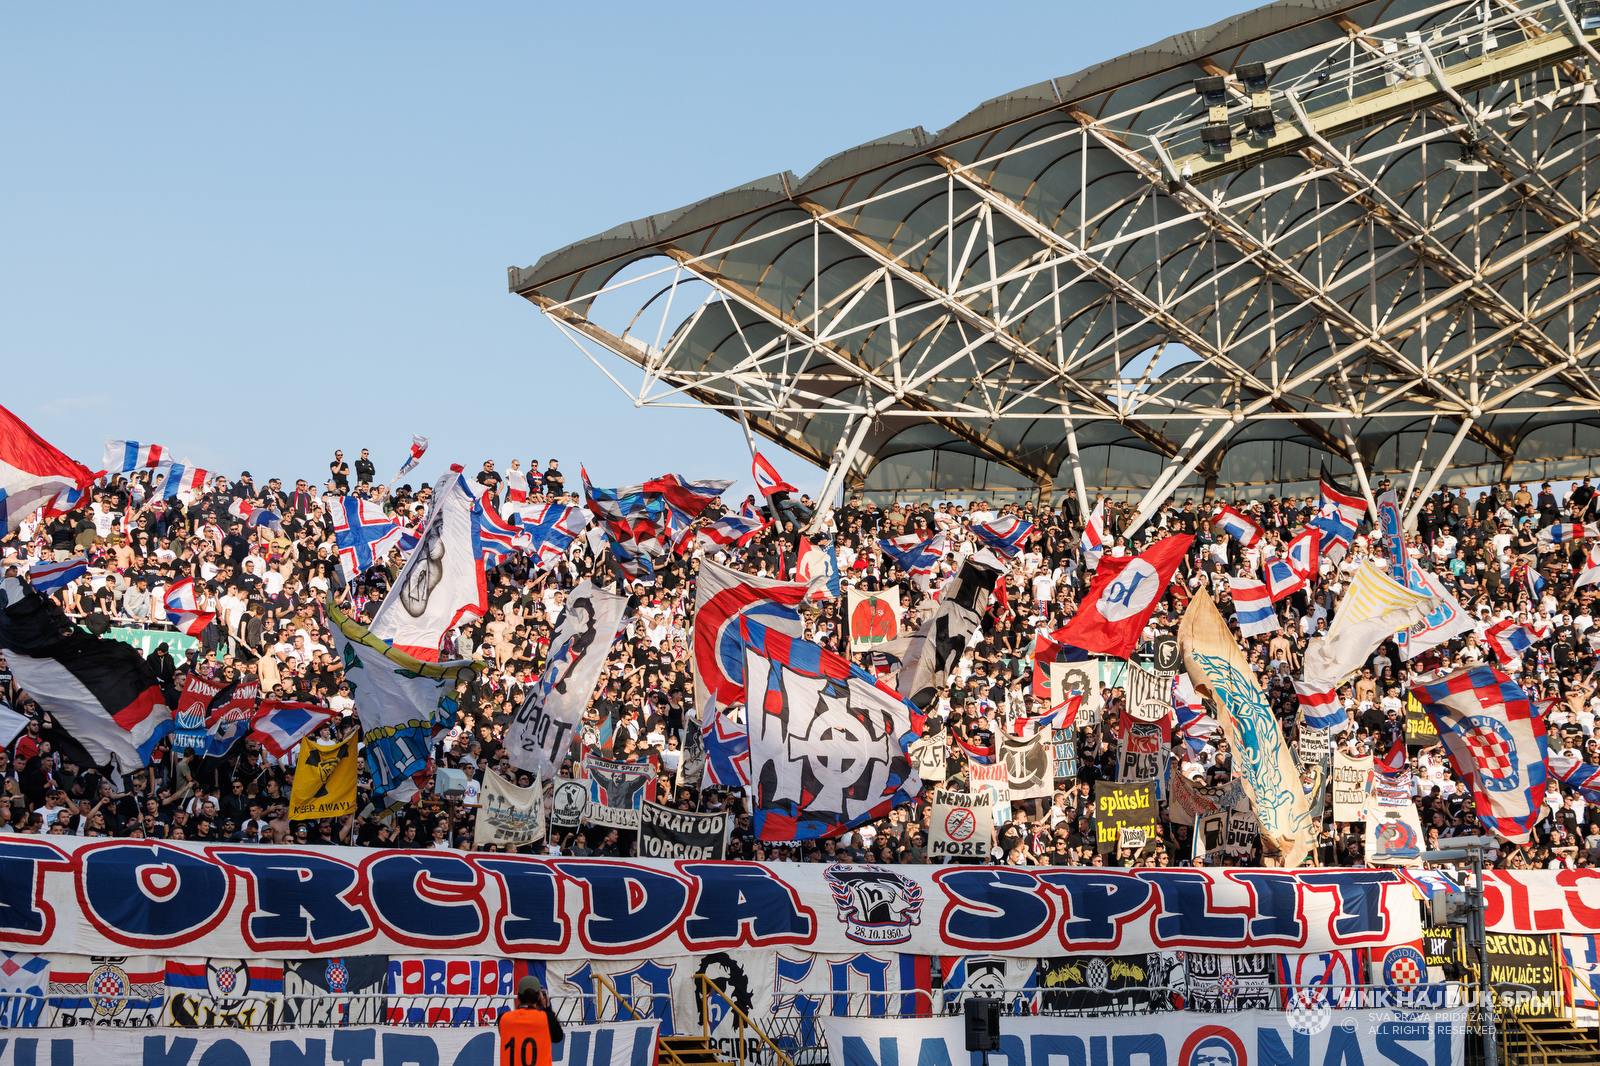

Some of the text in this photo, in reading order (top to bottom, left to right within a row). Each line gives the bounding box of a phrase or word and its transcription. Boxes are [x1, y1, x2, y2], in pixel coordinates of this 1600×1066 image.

[594, 760, 619, 770] HAJDUK
[293, 801, 351, 815] KEEP AWAY!
[936, 790, 972, 808] NEMA
[974, 792, 990, 807] NA
[1100, 788, 1150, 817] splitski
[642, 804, 724, 835] STRAH OD
[642, 835, 714, 860] TORCIDE
[933, 840, 987, 856] MORE
[0, 838, 815, 955] TORCIDA
[933, 866, 1405, 953] SPLIT
[1421, 927, 1453, 939] MAČAK
[1486, 933, 1549, 957] ORCIDA
[1387, 949, 1421, 965] HAJDUK
[96, 971, 122, 984] HAJDUK
[387, 959, 514, 995] TORCIDA
[1491, 962, 1541, 985] NAVIJAČE
[504, 1037, 538, 1066] 10
